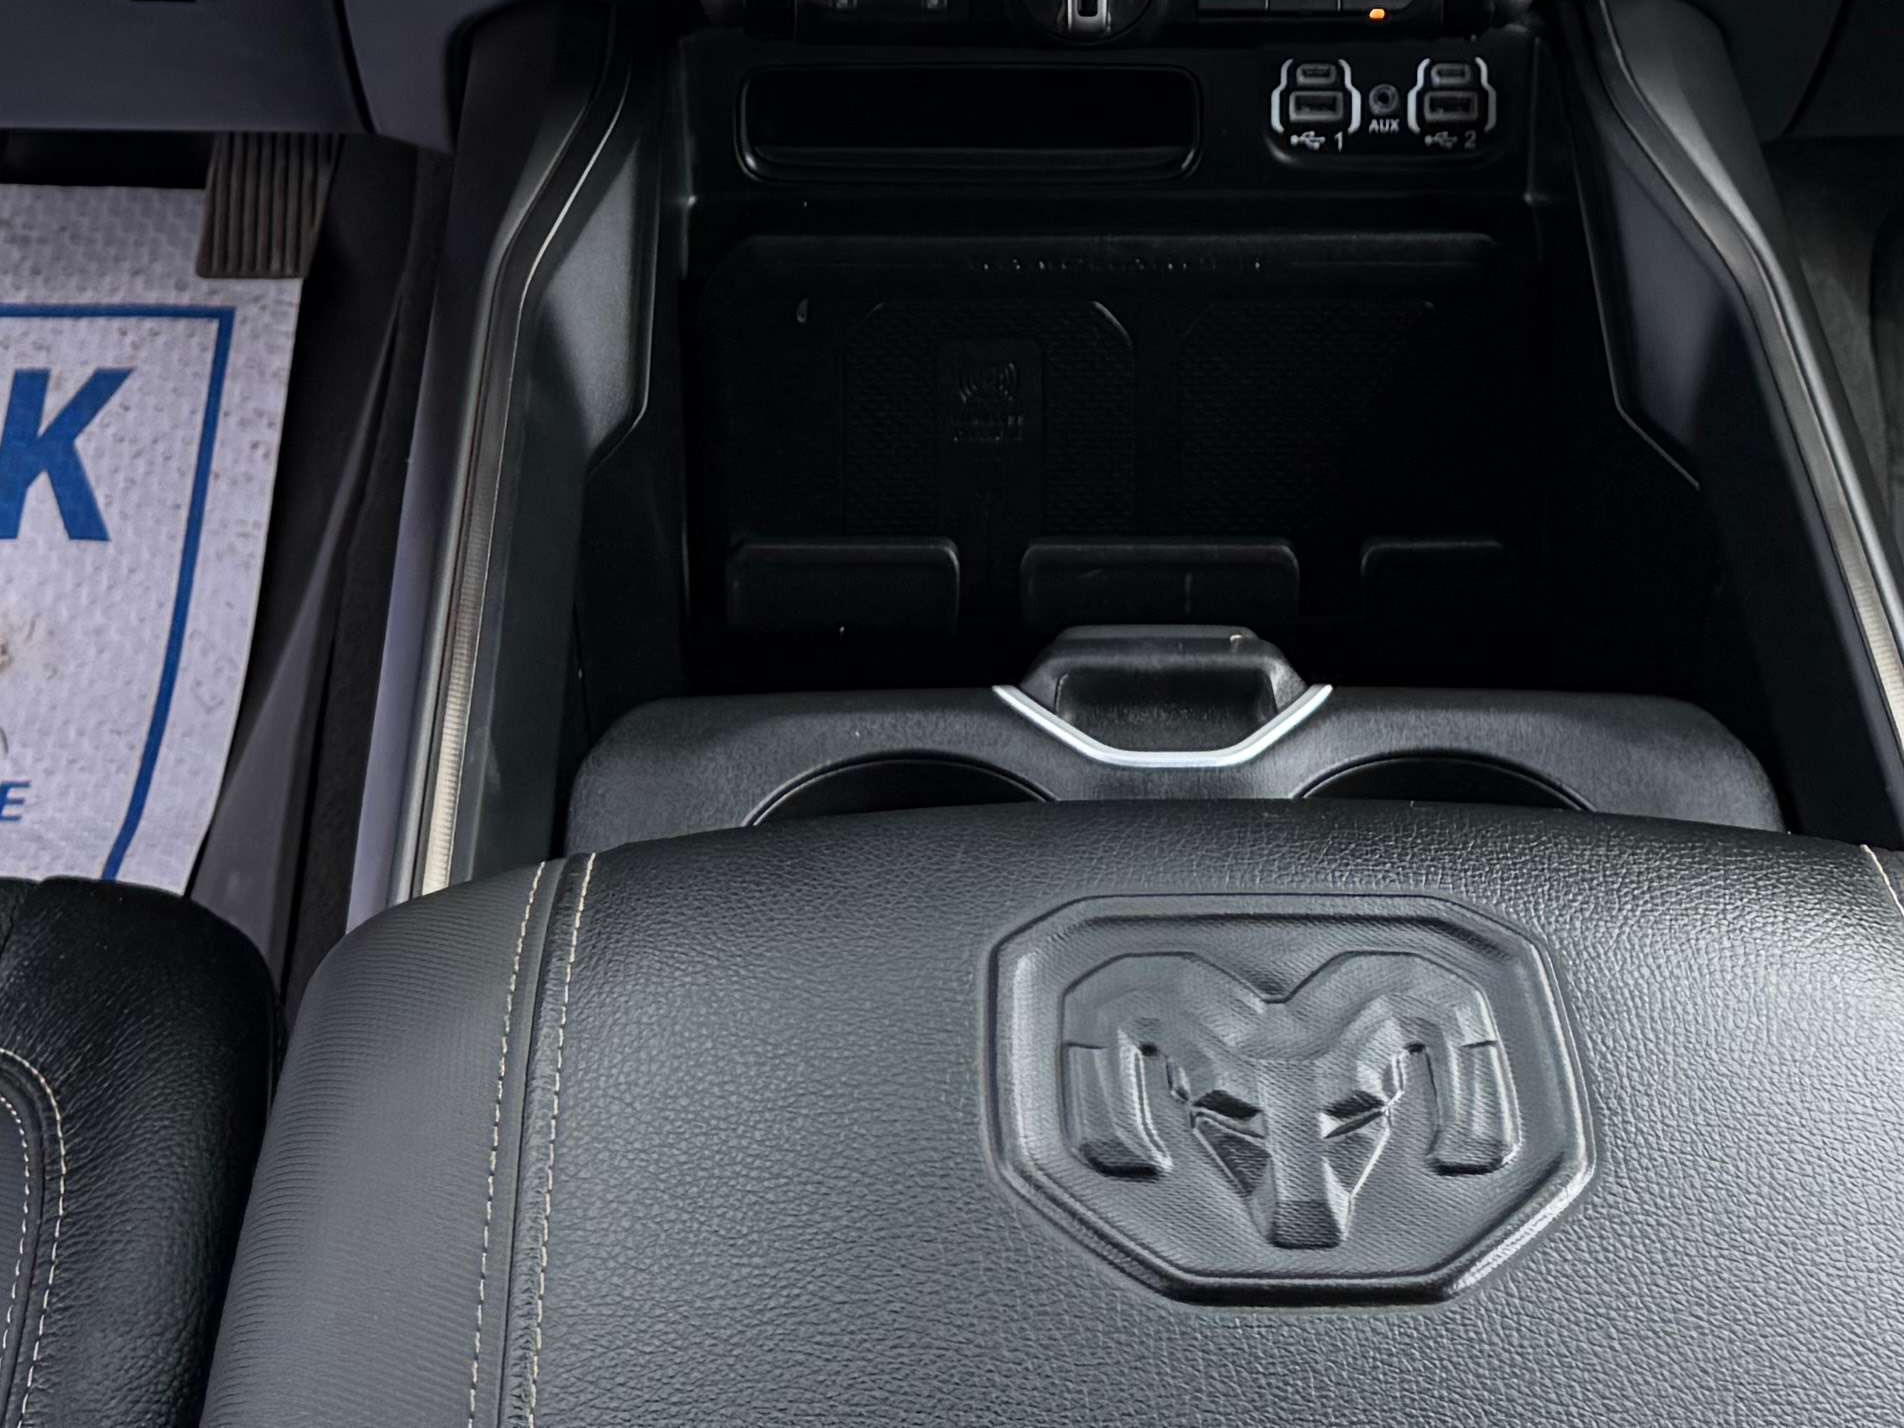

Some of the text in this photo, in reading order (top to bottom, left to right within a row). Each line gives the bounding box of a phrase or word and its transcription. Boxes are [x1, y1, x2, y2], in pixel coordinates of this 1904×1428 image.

[1368, 119, 1400, 133] AUX
[1335, 132, 1344, 152] 1
[1464, 131, 1478, 149] 2
